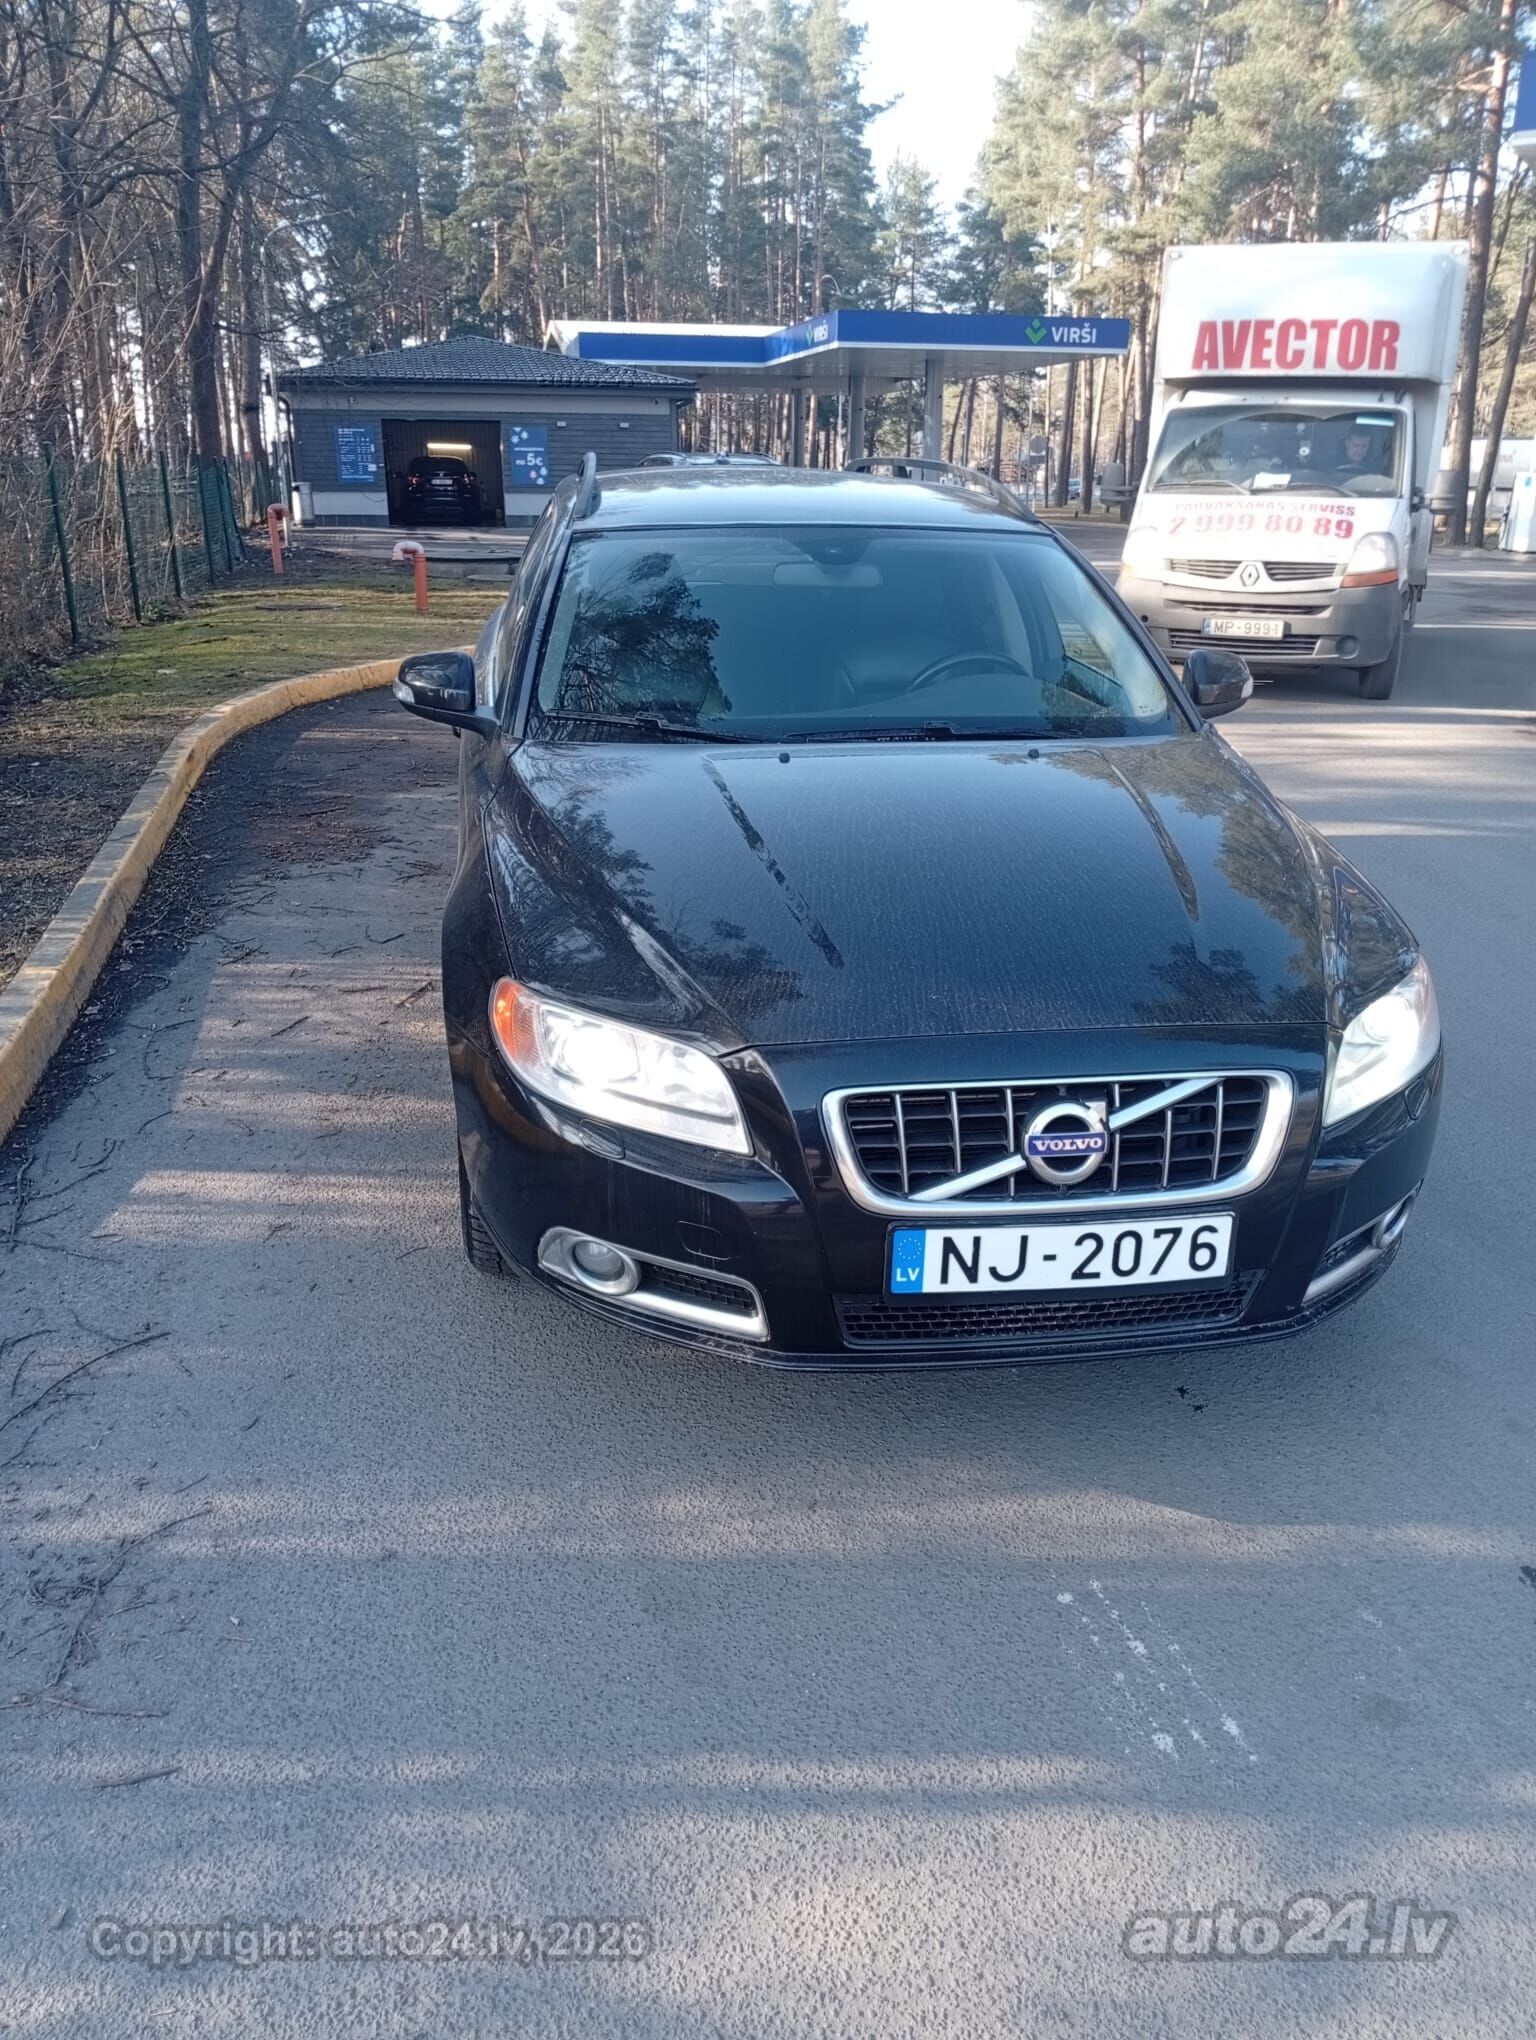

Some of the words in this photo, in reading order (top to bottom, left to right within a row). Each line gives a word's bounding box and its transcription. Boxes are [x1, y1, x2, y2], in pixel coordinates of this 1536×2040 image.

[1051, 322, 1097, 344] VIRŠI
[1191, 317, 1401, 371] AVECTOR
[1168, 515, 1188, 536] 2
[1194, 513, 1256, 534] 999
[1264, 513, 1304, 534] 80
[1313, 516, 1355, 540] 89
[1032, 1137, 1103, 1152] VOLVO
[895, 1266, 921, 1282] LV
[939, 1224, 1221, 1286] NJ-2076
